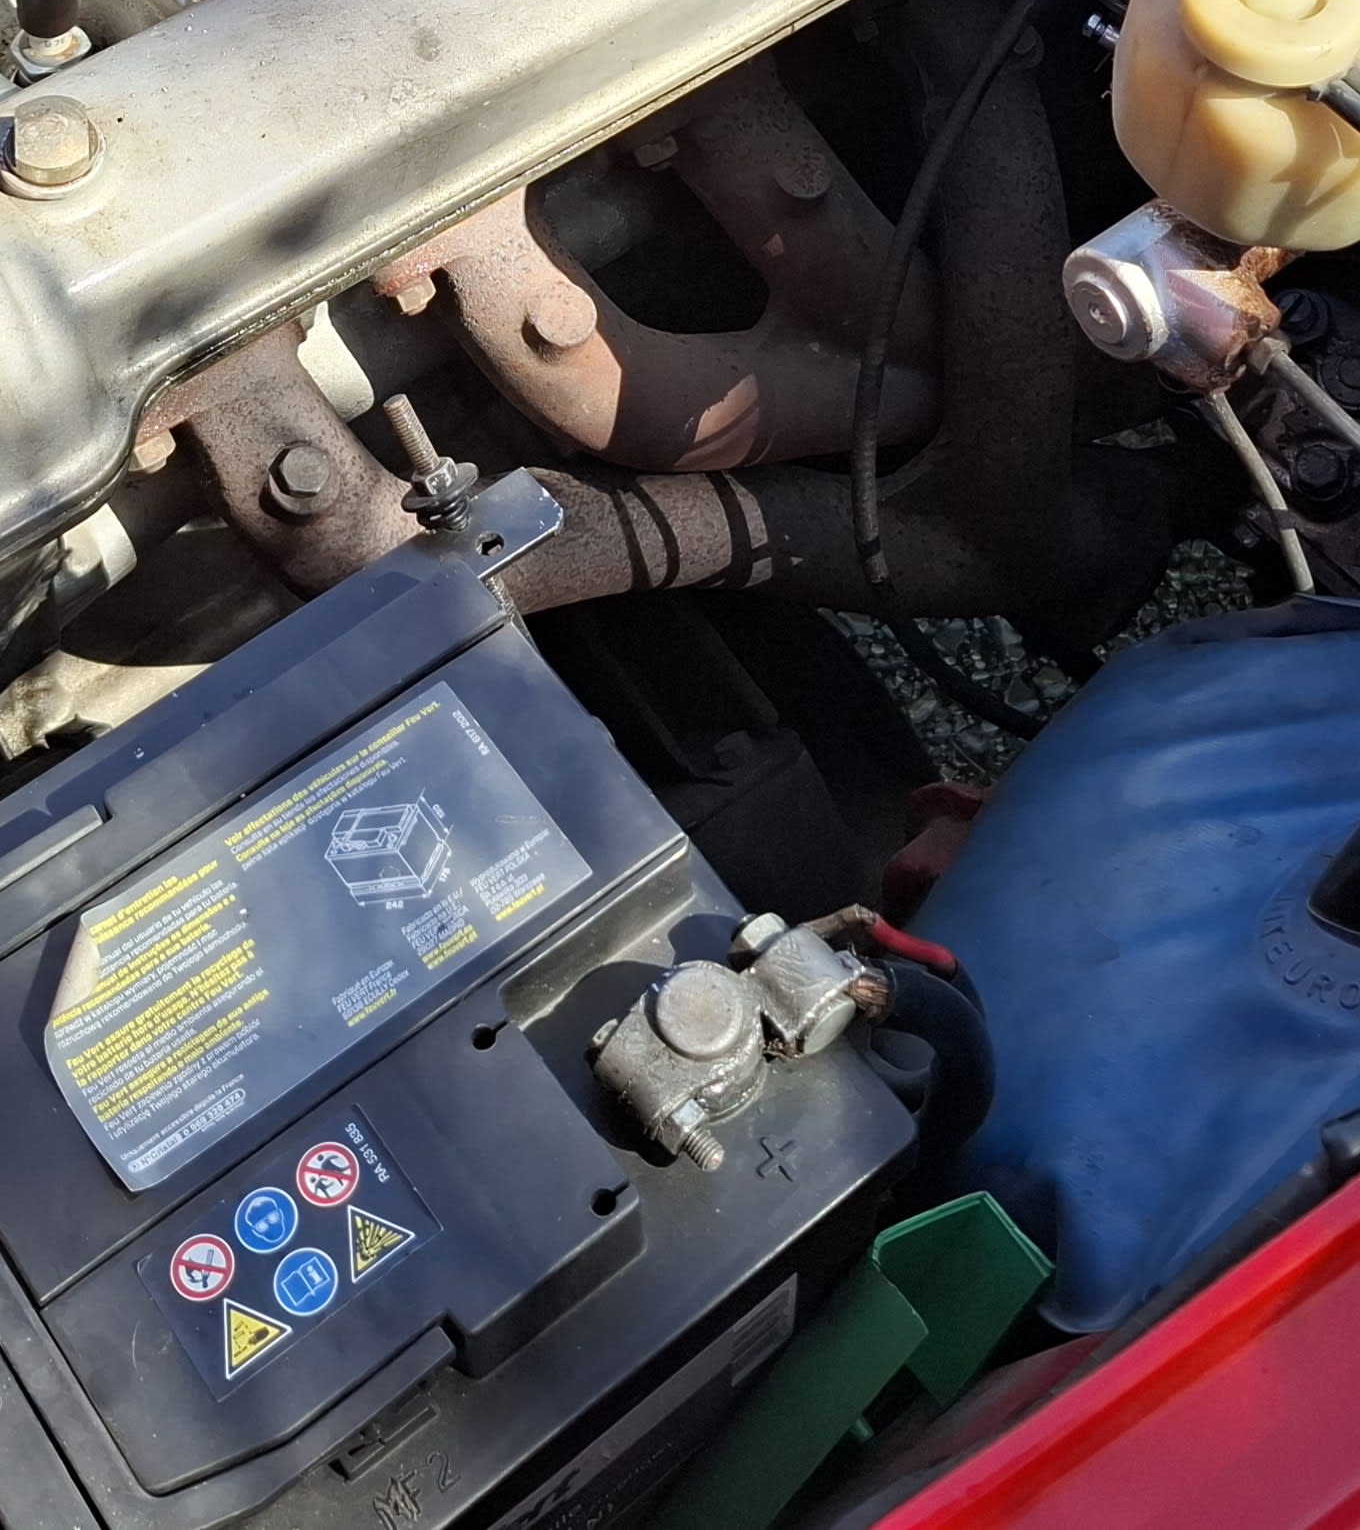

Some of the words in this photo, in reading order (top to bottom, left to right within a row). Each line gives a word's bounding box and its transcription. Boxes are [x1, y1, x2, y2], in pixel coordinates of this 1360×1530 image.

[477, 741, 489, 755] RA
[224, 831, 242, 846] Voir
[404, 713, 420, 726] Feu
[203, 984, 222, 999] Feu
[65, 1055, 84, 1069] Feu
[82, 1041, 104, 1058] Vert
[345, 1122, 363, 1143] 835
[359, 1143, 377, 1164] 531
[374, 1162, 389, 1182] RA
[426, 1449, 462, 1491] 2
